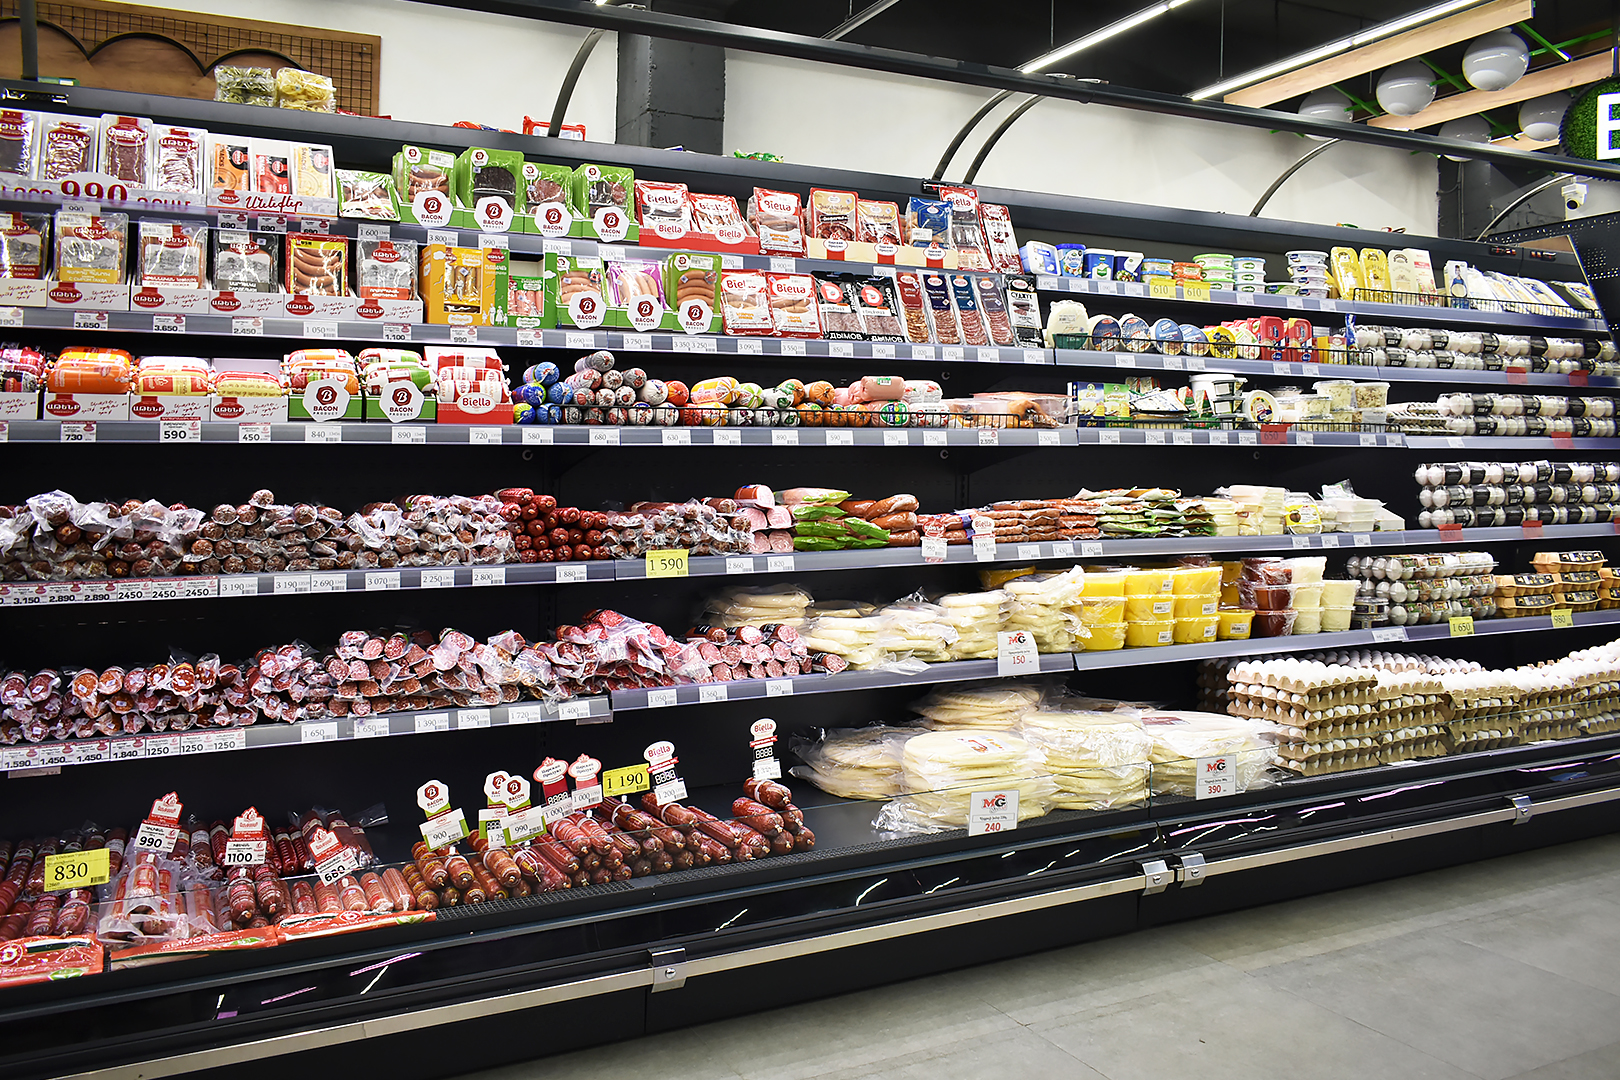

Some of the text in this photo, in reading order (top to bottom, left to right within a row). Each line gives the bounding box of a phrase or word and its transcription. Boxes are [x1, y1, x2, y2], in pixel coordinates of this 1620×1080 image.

[61, 180, 127, 202] 990
[764, 200, 792, 212] Biella
[658, 224, 682, 234] Biella
[719, 229, 742, 239] Biella
[776, 285, 806, 295] Biella
[1153, 285, 1169, 295] 610
[1187, 288, 1202, 298] 610
[50, 291, 82, 299] ԱԹԵՆՔ
[134, 295, 165, 303] ԱԹԵՆՔ
[212, 300, 241, 308] ԱԹԵՆՔ
[286, 304, 315, 312] ԱԹԵՆՔ
[356, 308, 384, 316] ԱԹԵՆՔ
[462, 396, 491, 407] Biella
[47, 403, 80, 411] ԱԹԵՆՔ
[133, 405, 164, 413] ԱԹԵՆՔ
[213, 406, 245, 414] ԱԹԵՆՔ
[163, 430, 187, 439] 590
[242, 433, 260, 441] 450
[311, 430, 326, 438] 840
[397, 431, 411, 439] 890
[475, 431, 488, 439] 720
[1263, 431, 1278, 440] 650
[84, 593, 111, 601] 2.890
[118, 591, 143, 600] 2450
[152, 590, 176, 598] 2450
[186, 588, 209, 597] 2450
[49, 594, 76, 602] 2.890
[1013, 655, 1026, 665] 150
[754, 722, 773, 733] Biella
[182, 743, 204, 752] 1250
[213, 740, 235, 750] 1250
[113, 749, 139, 759] 1.840
[147, 746, 170, 756] 1250
[648, 744, 671, 757] Biella
[40, 756, 66, 765] 1.450
[76, 753, 102, 762] 1.450
[5, 760, 32, 768] 1.590
[1208, 785, 1222, 794] 390
[515, 824, 529, 834] 990
[984, 822, 1001, 832] 240
[432, 831, 447, 842] 900
[139, 835, 163, 848] 990
[227, 852, 253, 864] 1100
[54, 862, 88, 881] 830
[324, 865, 346, 883] 680
